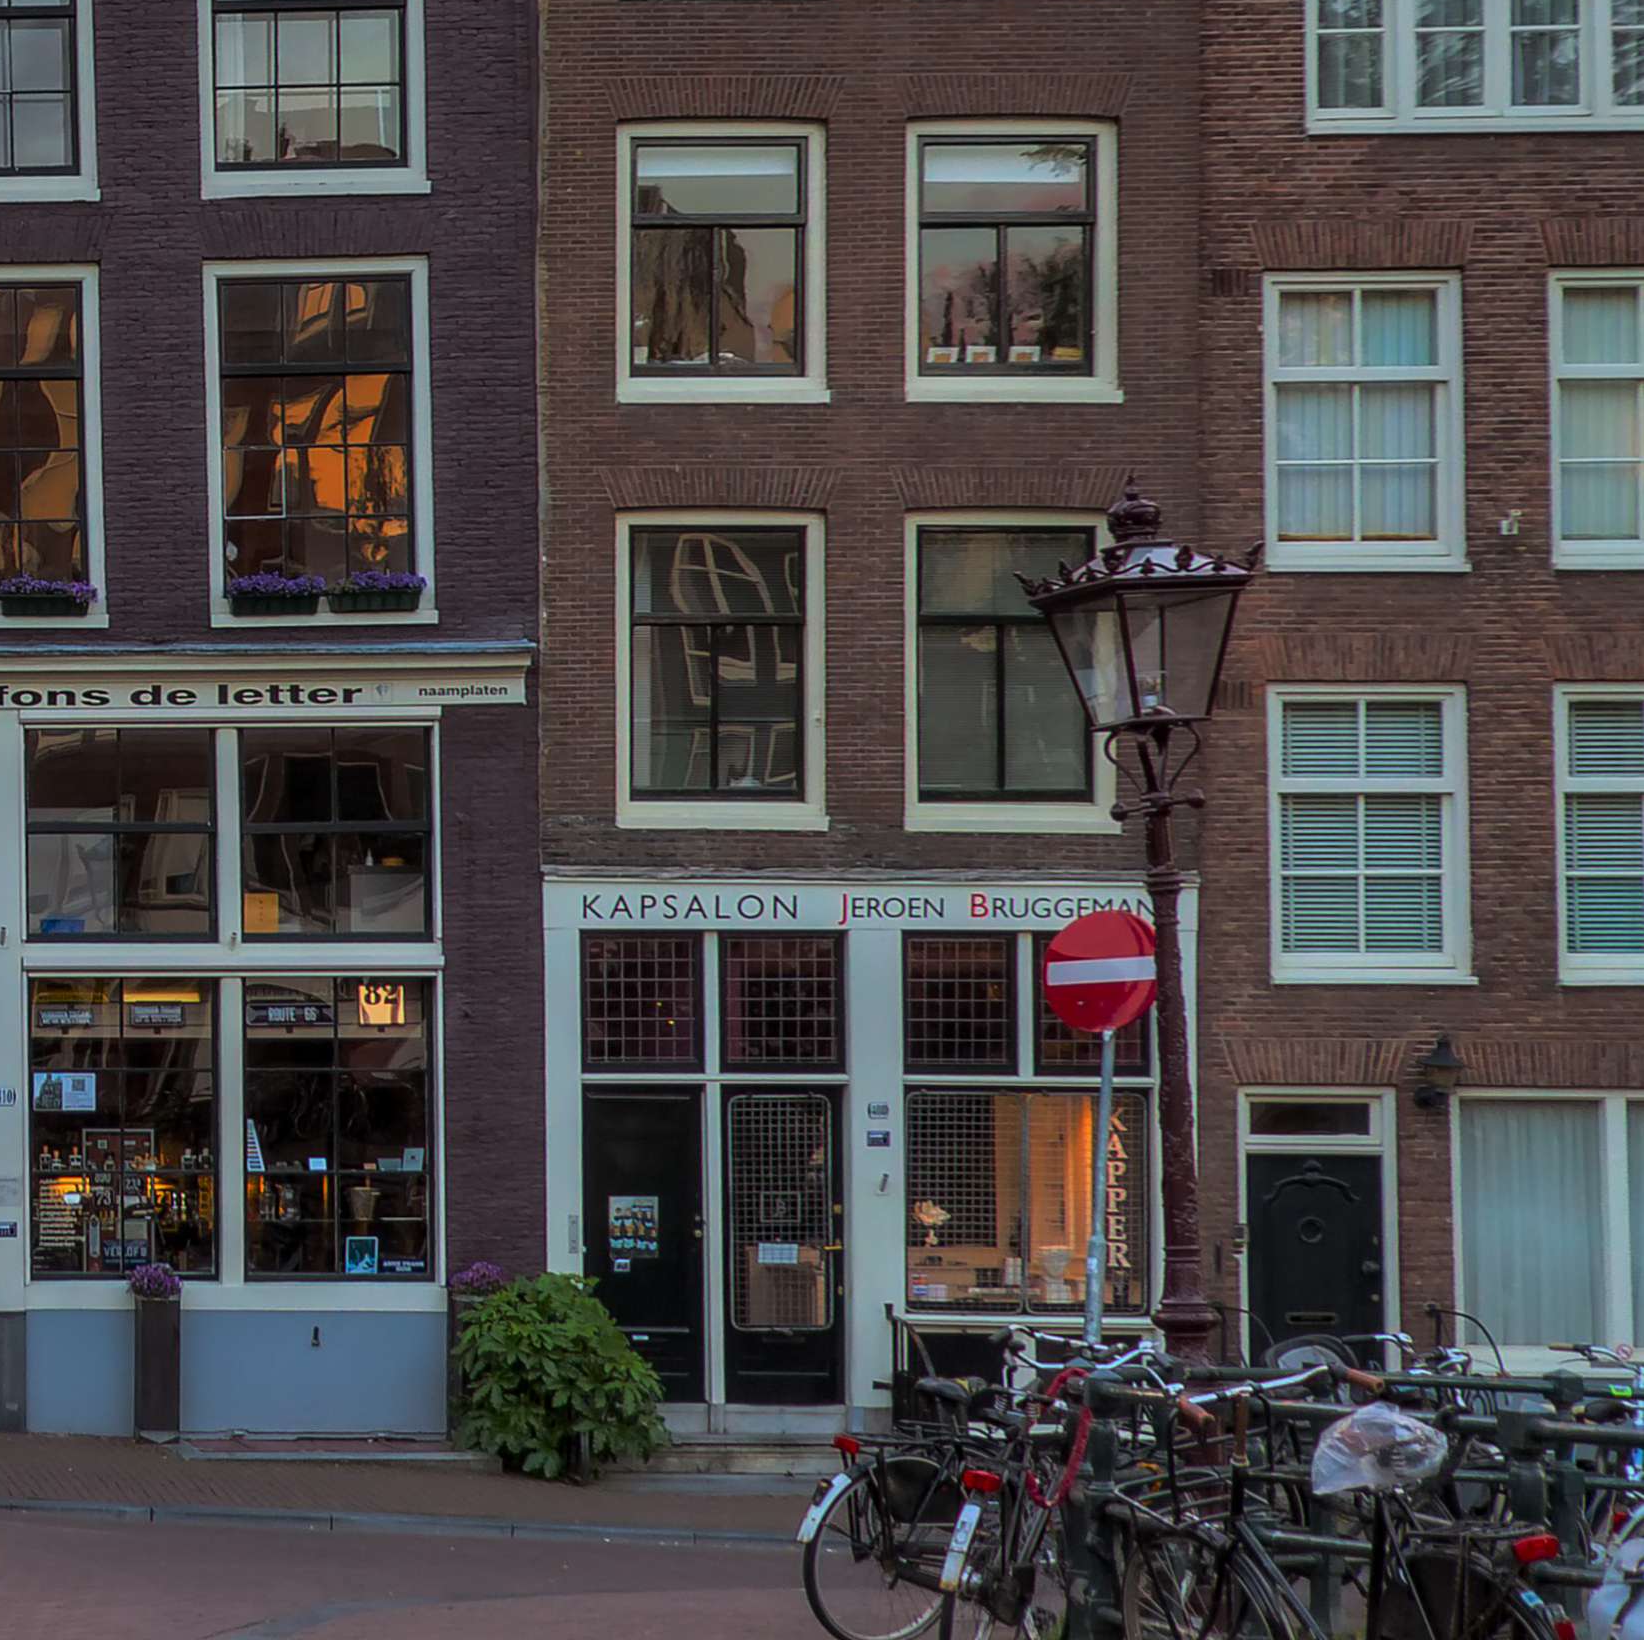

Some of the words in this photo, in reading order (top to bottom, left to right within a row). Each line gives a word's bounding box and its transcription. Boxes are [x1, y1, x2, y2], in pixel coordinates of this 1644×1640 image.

[129, 684, 197, 706] de
[217, 683, 362, 706] letter
[418, 683, 508, 700] naamplaten
[581, 893, 799, 920] KAPSALON
[839, 892, 946, 925] JEROEN
[267, 1007, 297, 1022] ROUTE
[304, 1006, 317, 1021] 66
[1106, 1107, 1131, 1268] KAPPER
